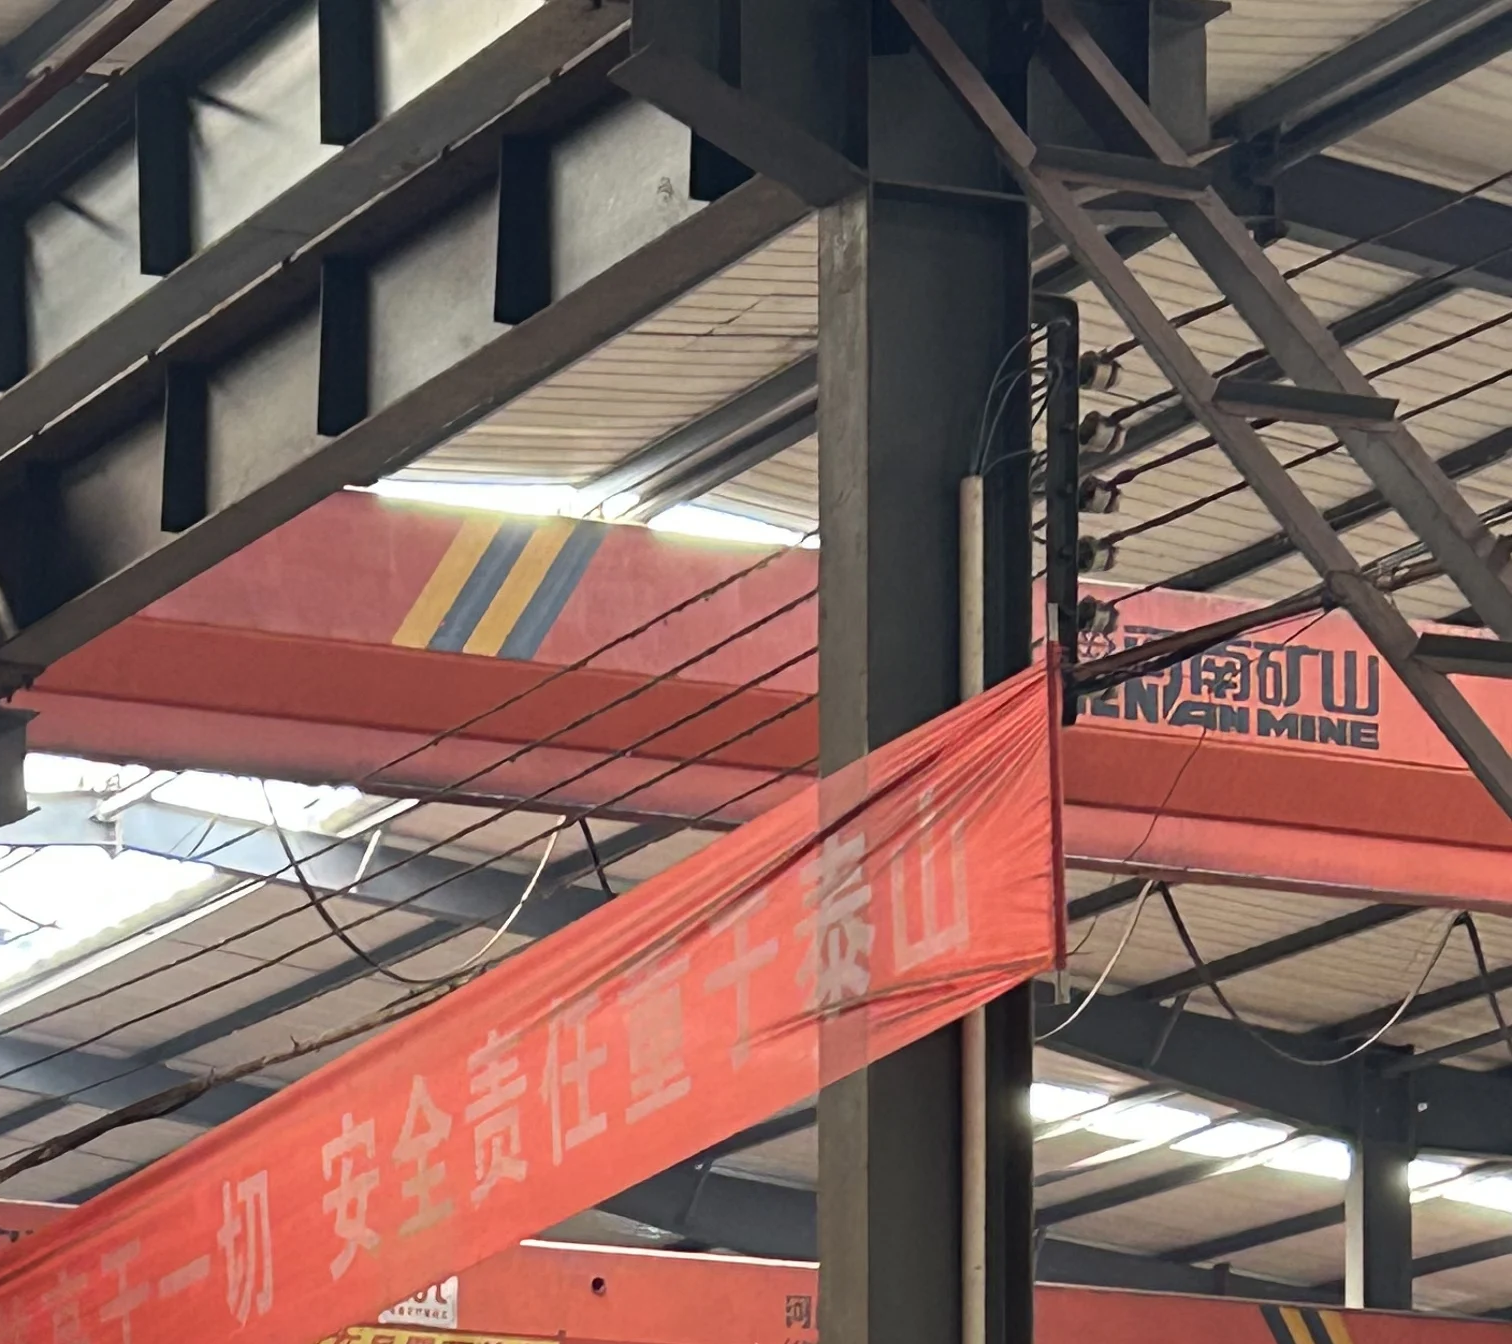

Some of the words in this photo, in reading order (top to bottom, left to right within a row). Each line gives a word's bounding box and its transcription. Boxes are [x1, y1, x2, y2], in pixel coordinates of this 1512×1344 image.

[1257, 708, 1380, 750] MINE
[321, 788, 970, 1281] 安全责任重于泰山
